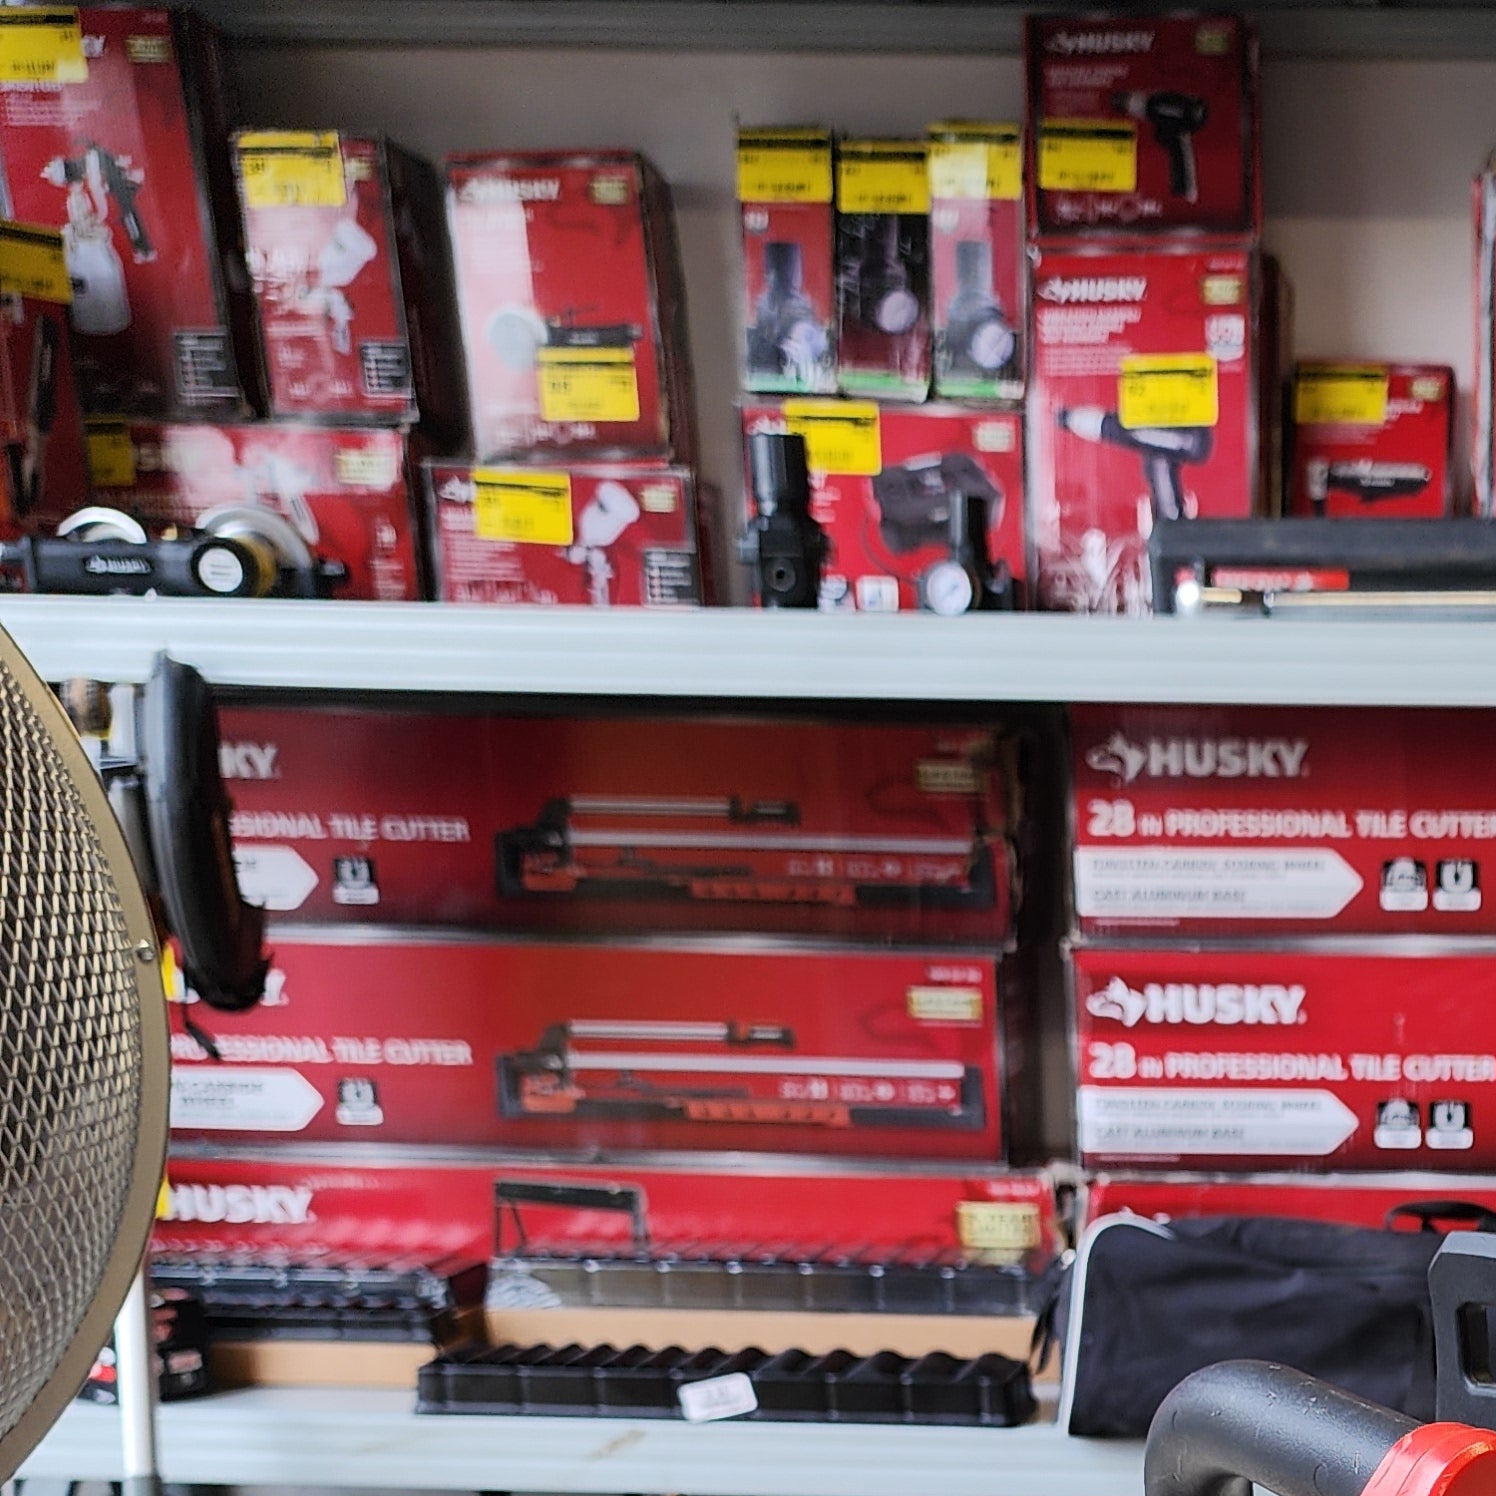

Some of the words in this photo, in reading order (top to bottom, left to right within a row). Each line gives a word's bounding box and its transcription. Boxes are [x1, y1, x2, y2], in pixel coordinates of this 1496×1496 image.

[1069, 275, 1148, 302] HUSKY
[1146, 740, 1309, 778] HUSKY
[328, 814, 379, 840] TILE
[380, 816, 471, 843] CUTTER
[1087, 800, 1136, 838] 28
[1164, 811, 1352, 839] PROFESSIONAL
[1355, 811, 1407, 840] TILE
[1145, 984, 1303, 1025] HUSKY
[331, 1037, 383, 1064] TILE
[383, 1037, 474, 1066] CUTTER
[1087, 1043, 1137, 1079] 28
[1164, 1054, 1349, 1081] PROFESSIONAL
[1350, 1055, 1402, 1081] TILE
[170, 1184, 313, 1225] HUSKY
